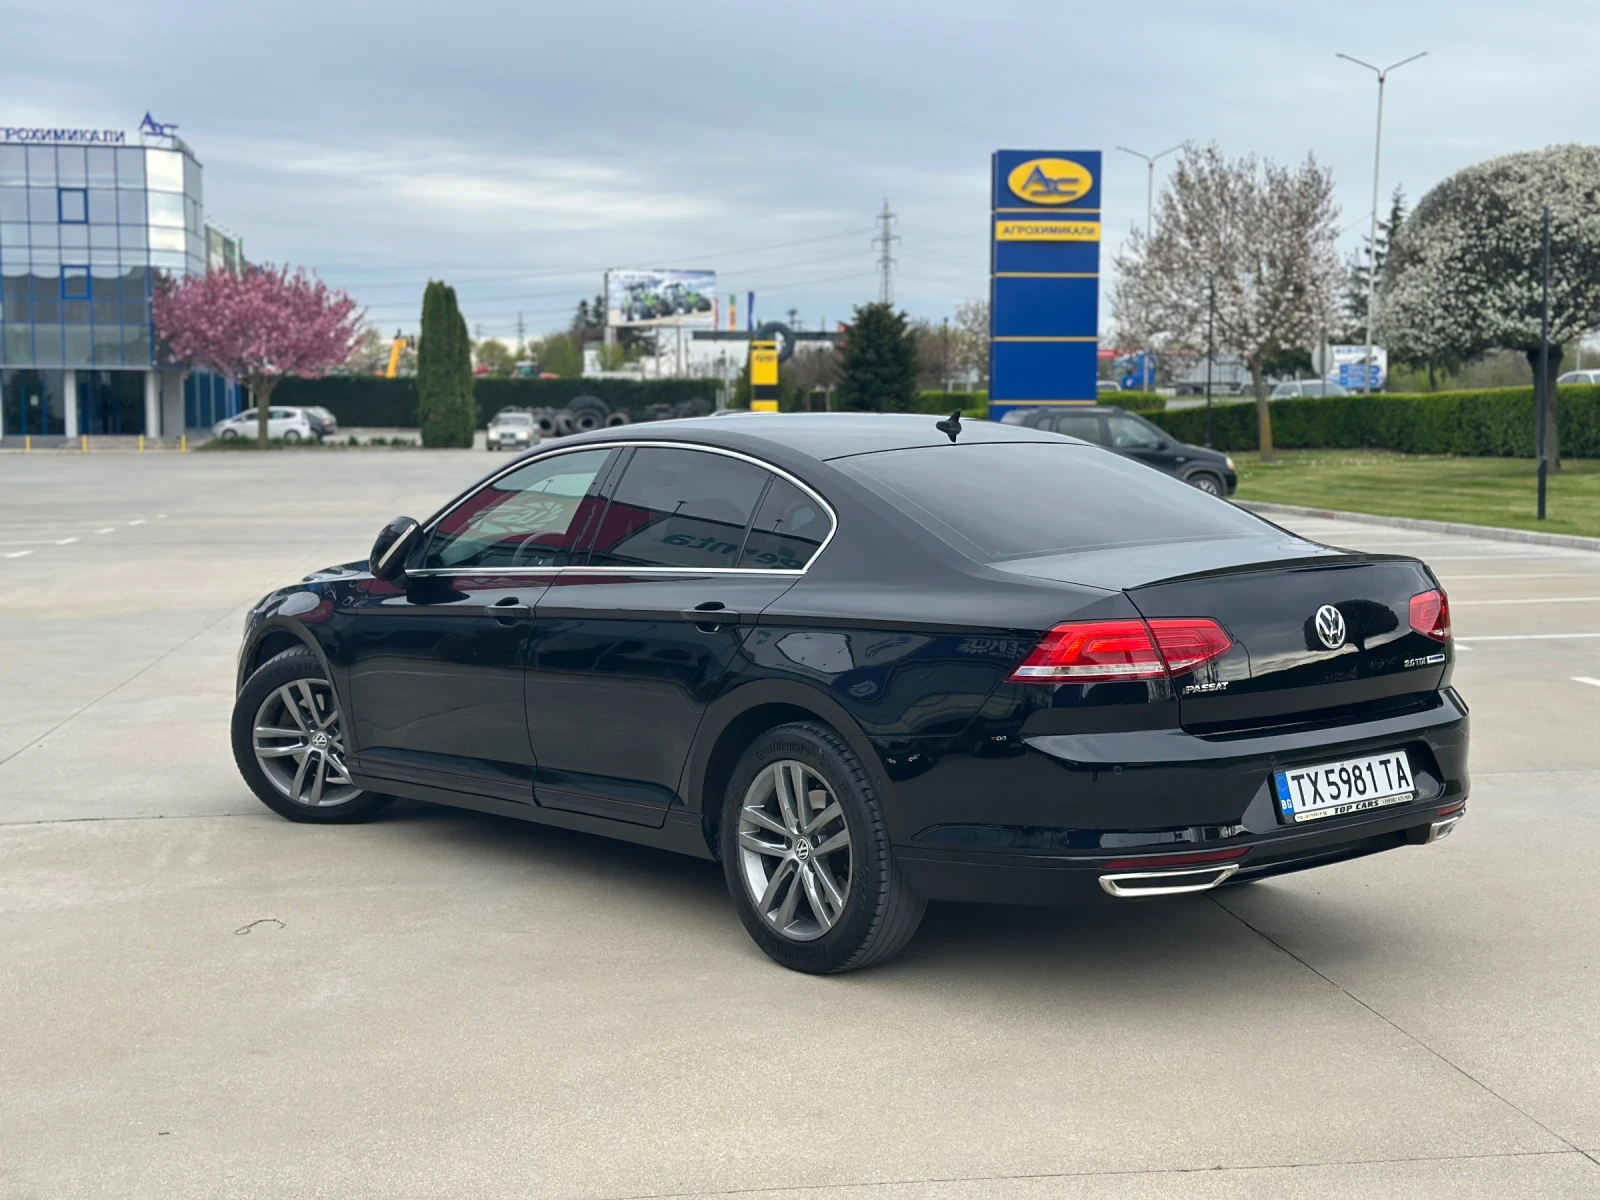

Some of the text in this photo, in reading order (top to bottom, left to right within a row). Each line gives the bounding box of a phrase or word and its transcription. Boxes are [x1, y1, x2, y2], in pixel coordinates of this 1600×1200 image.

[0, 127, 125, 143] РОХИМИКАЛИ
[1184, 681, 1229, 695] PASSAT
[1291, 757, 1410, 807] TX 5981 TA
[1282, 799, 1293, 810] BG
[1334, 800, 1379, 814] TOP CARS
